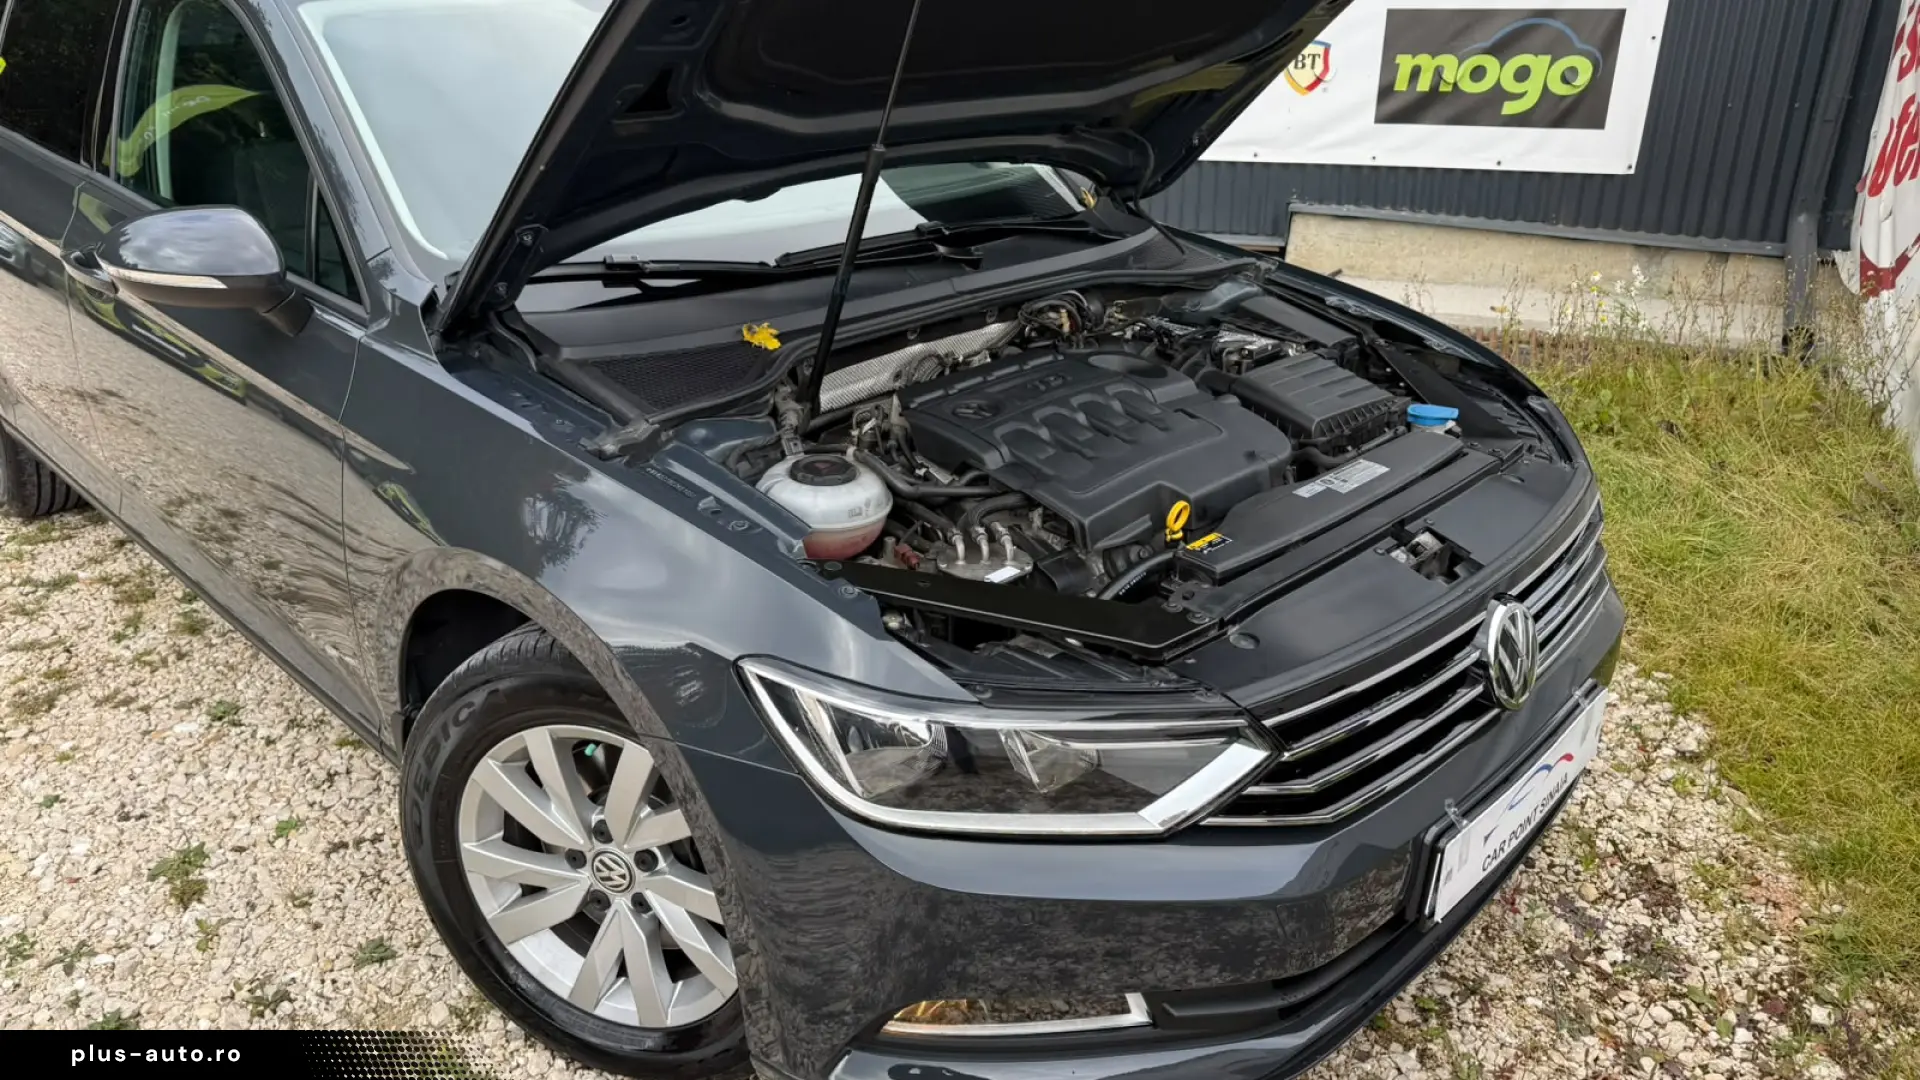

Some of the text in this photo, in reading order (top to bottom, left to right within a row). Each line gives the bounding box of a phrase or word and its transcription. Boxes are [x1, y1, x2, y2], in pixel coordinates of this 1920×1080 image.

[1294, 53, 1321, 70] BT
[1393, 53, 1594, 115] mogo
[1482, 772, 1568, 872] CAR POINT SINAIA
